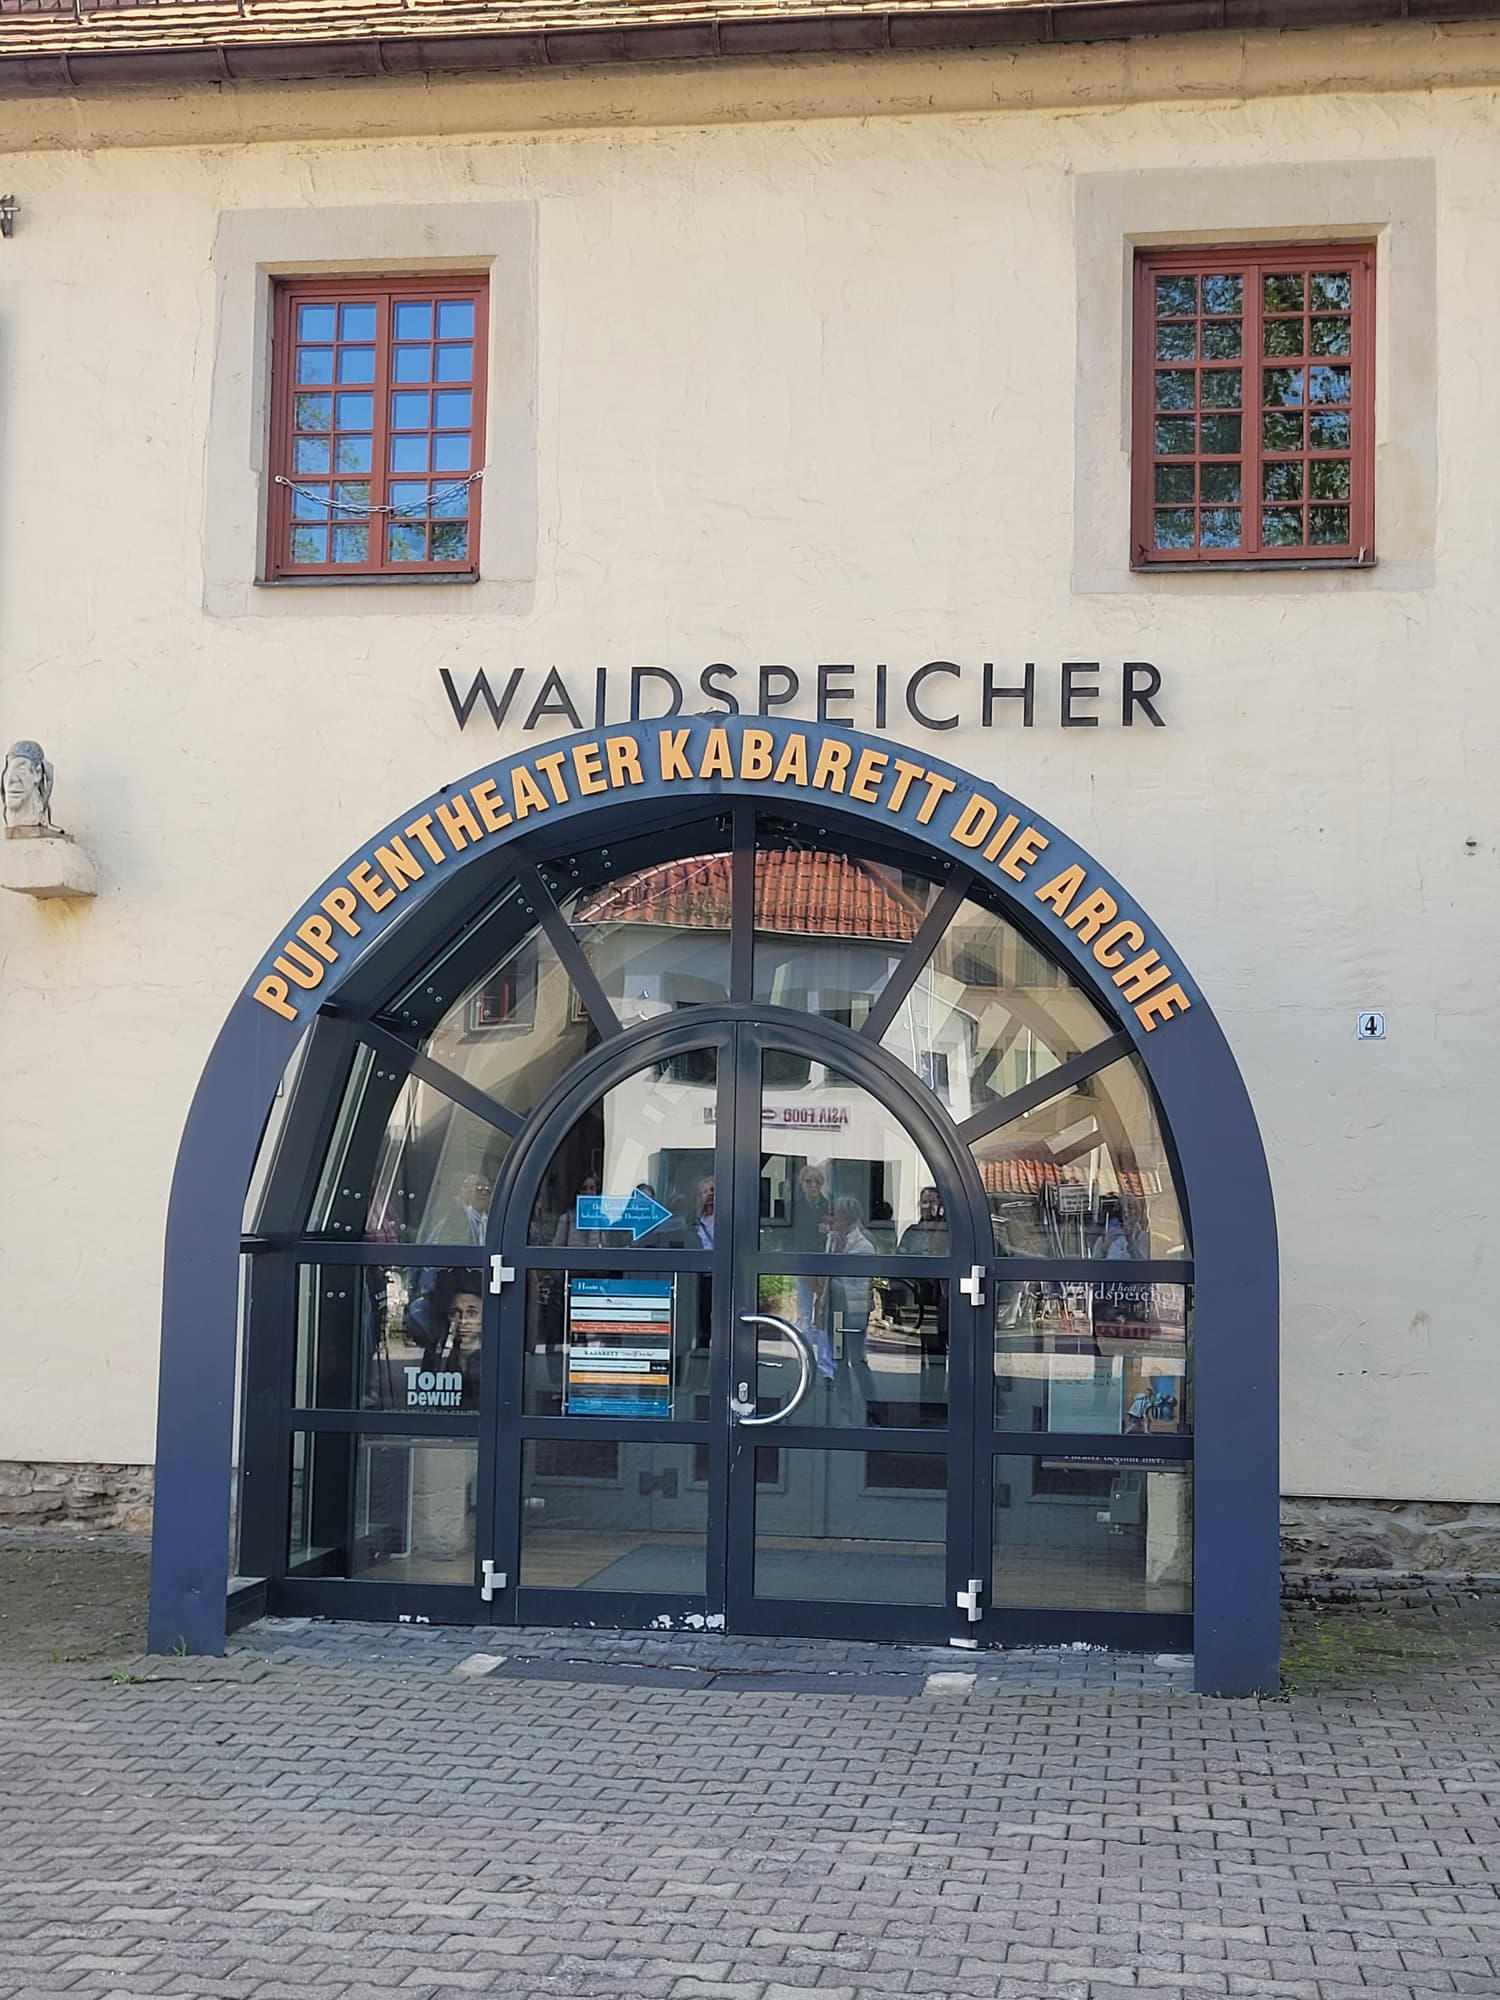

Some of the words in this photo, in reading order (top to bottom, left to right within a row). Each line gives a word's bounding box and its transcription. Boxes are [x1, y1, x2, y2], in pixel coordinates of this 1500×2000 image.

[438, 661, 1167, 731] WAIDSPEICHER
[252, 735, 644, 1023] PUPPENTHEATER
[659, 727, 956, 826] KABARETT
[950, 797, 1050, 883] DIE
[1034, 863, 1192, 1033] ARCHE
[1365, 1015, 1378, 1035] 4
[403, 1366, 462, 1391] Tom
